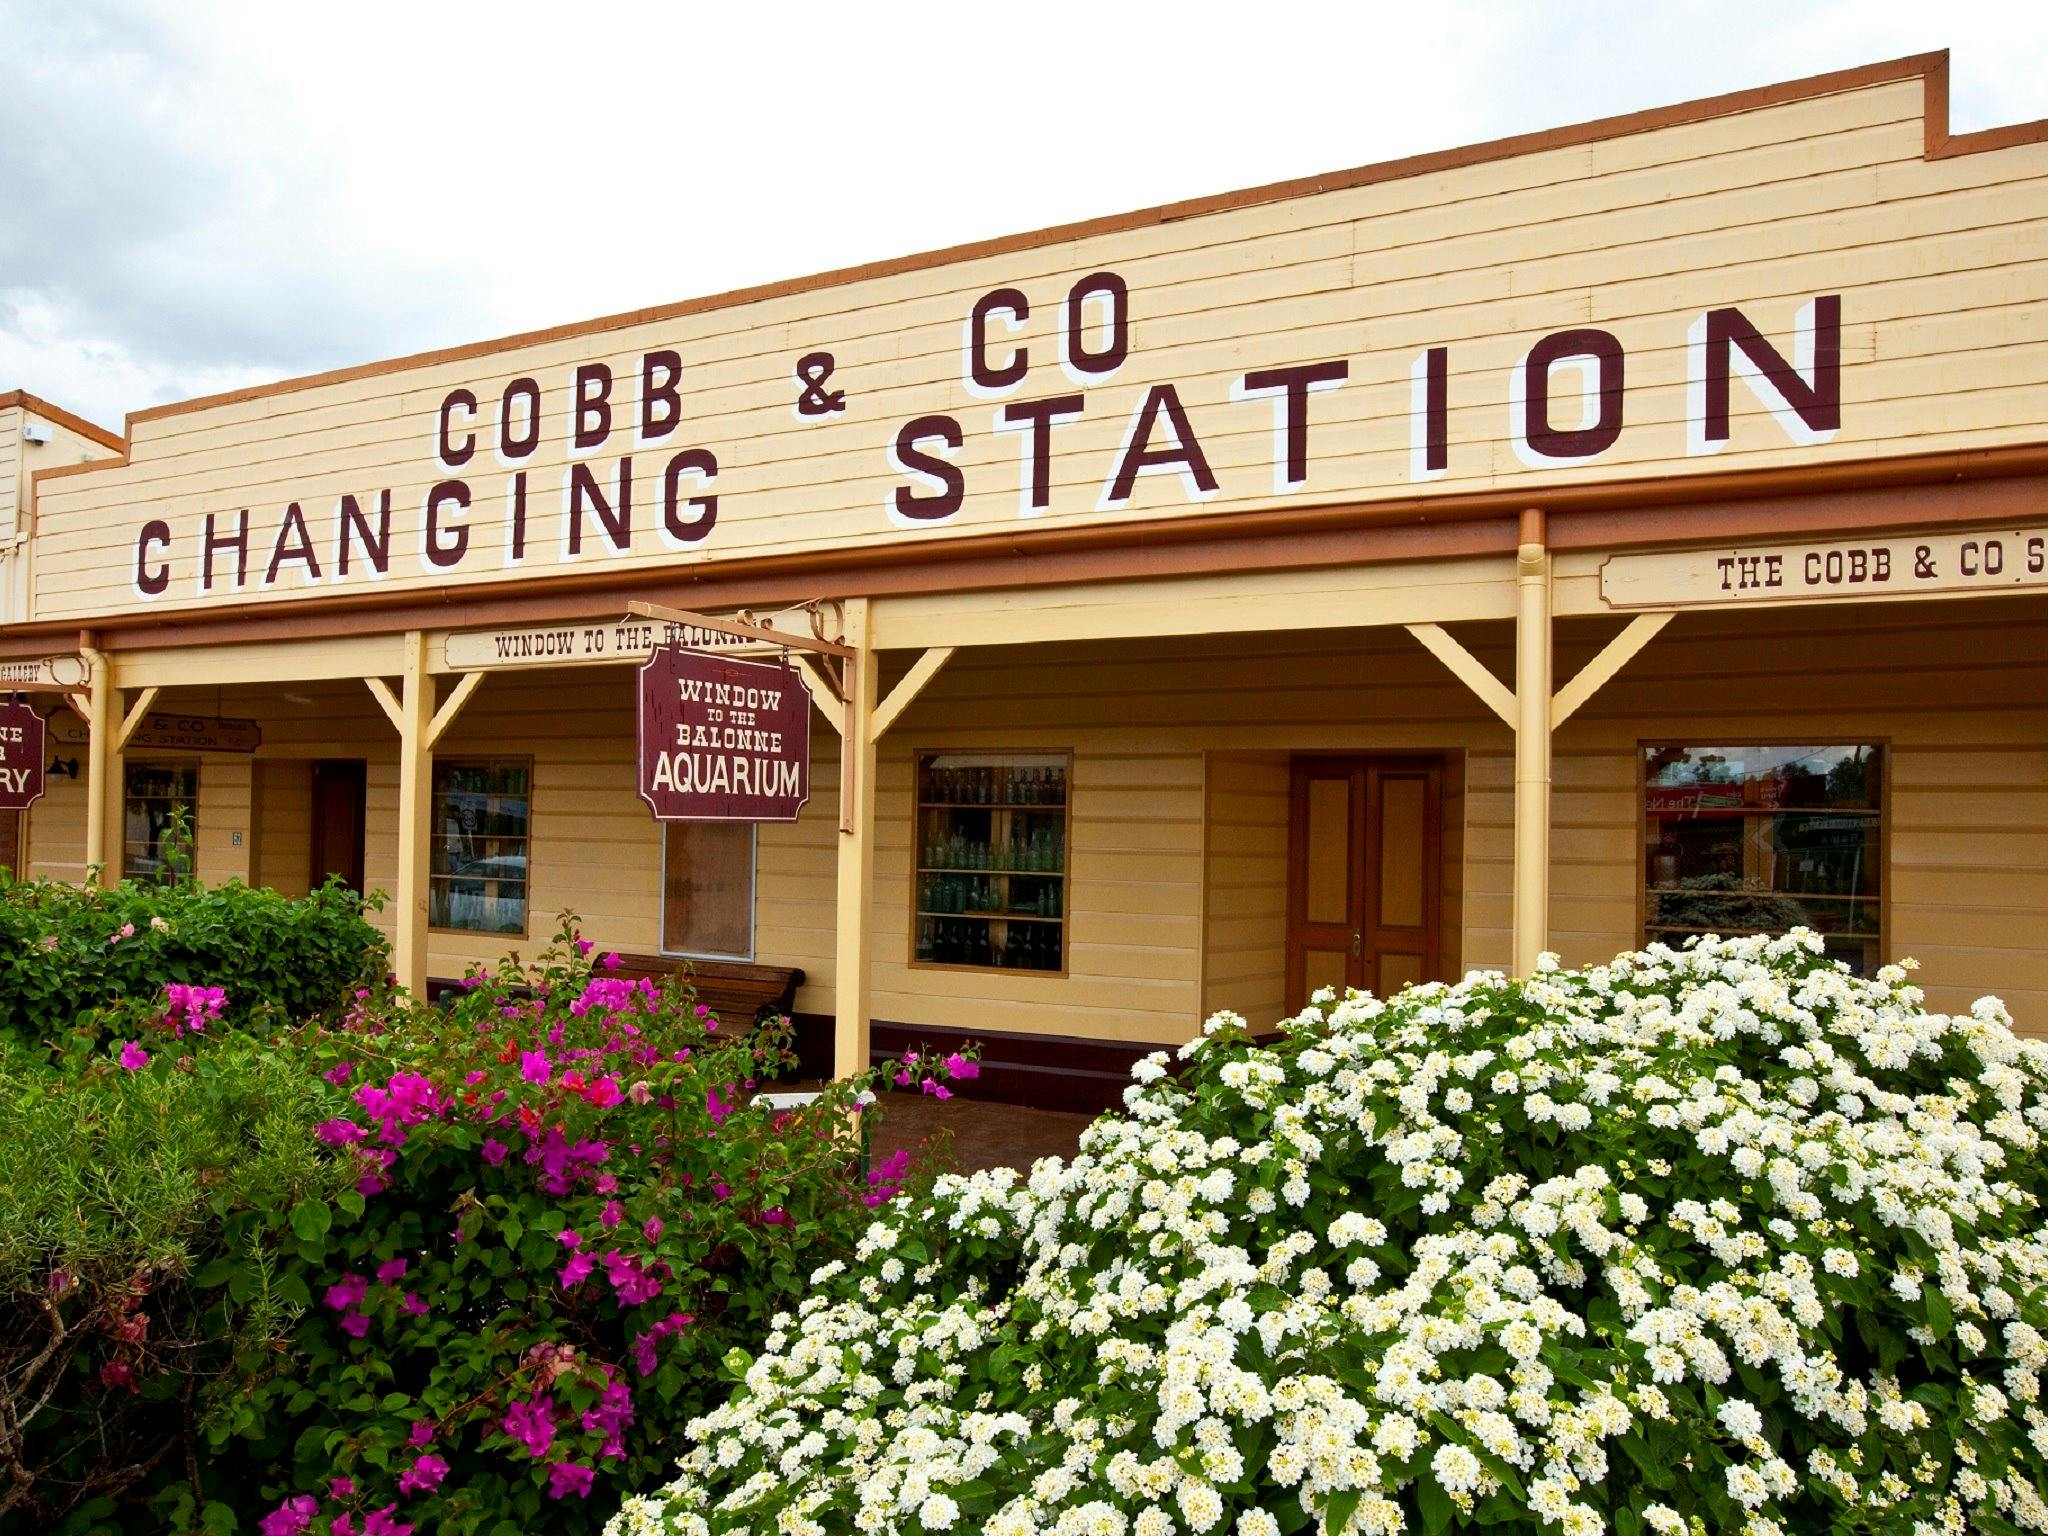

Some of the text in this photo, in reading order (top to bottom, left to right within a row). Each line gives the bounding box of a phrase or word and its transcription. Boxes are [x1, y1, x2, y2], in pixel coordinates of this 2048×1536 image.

[439, 271, 1129, 467] COBB & CO
[136, 294, 1841, 595] CHANGING STATION
[1717, 554, 1783, 591] THE
[1804, 547, 1892, 586] COBB
[1914, 544, 1938, 580] &
[1960, 540, 2004, 577] CO
[495, 630, 575, 659] WINDOW
[583, 629, 606, 653] TO
[615, 626, 652, 650] THE
[678, 678, 782, 712] WINDOW
[707, 708, 756, 726] TO THE
[158, 734, 218, 747] STATION
[675, 723, 782, 754] BALONNE
[651, 750, 800, 799] AQUARIUM
